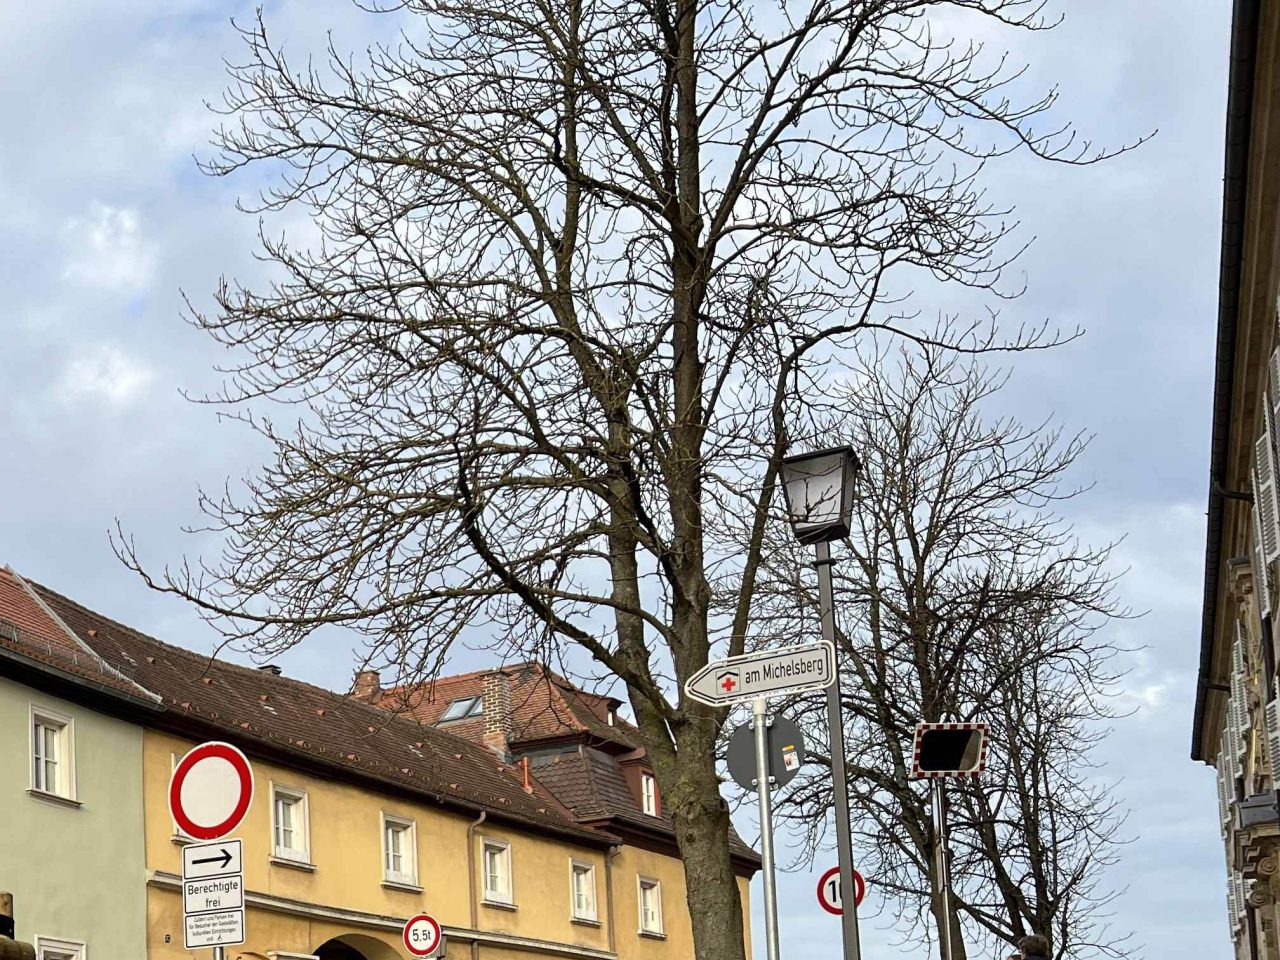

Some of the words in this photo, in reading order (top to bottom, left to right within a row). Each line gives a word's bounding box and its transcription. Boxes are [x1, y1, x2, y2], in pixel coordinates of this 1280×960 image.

[745, 670, 760, 683] am
[763, 658, 823, 680] Michelsberg
[188, 881, 238, 895] Berechtigte
[205, 897, 221, 908] frei
